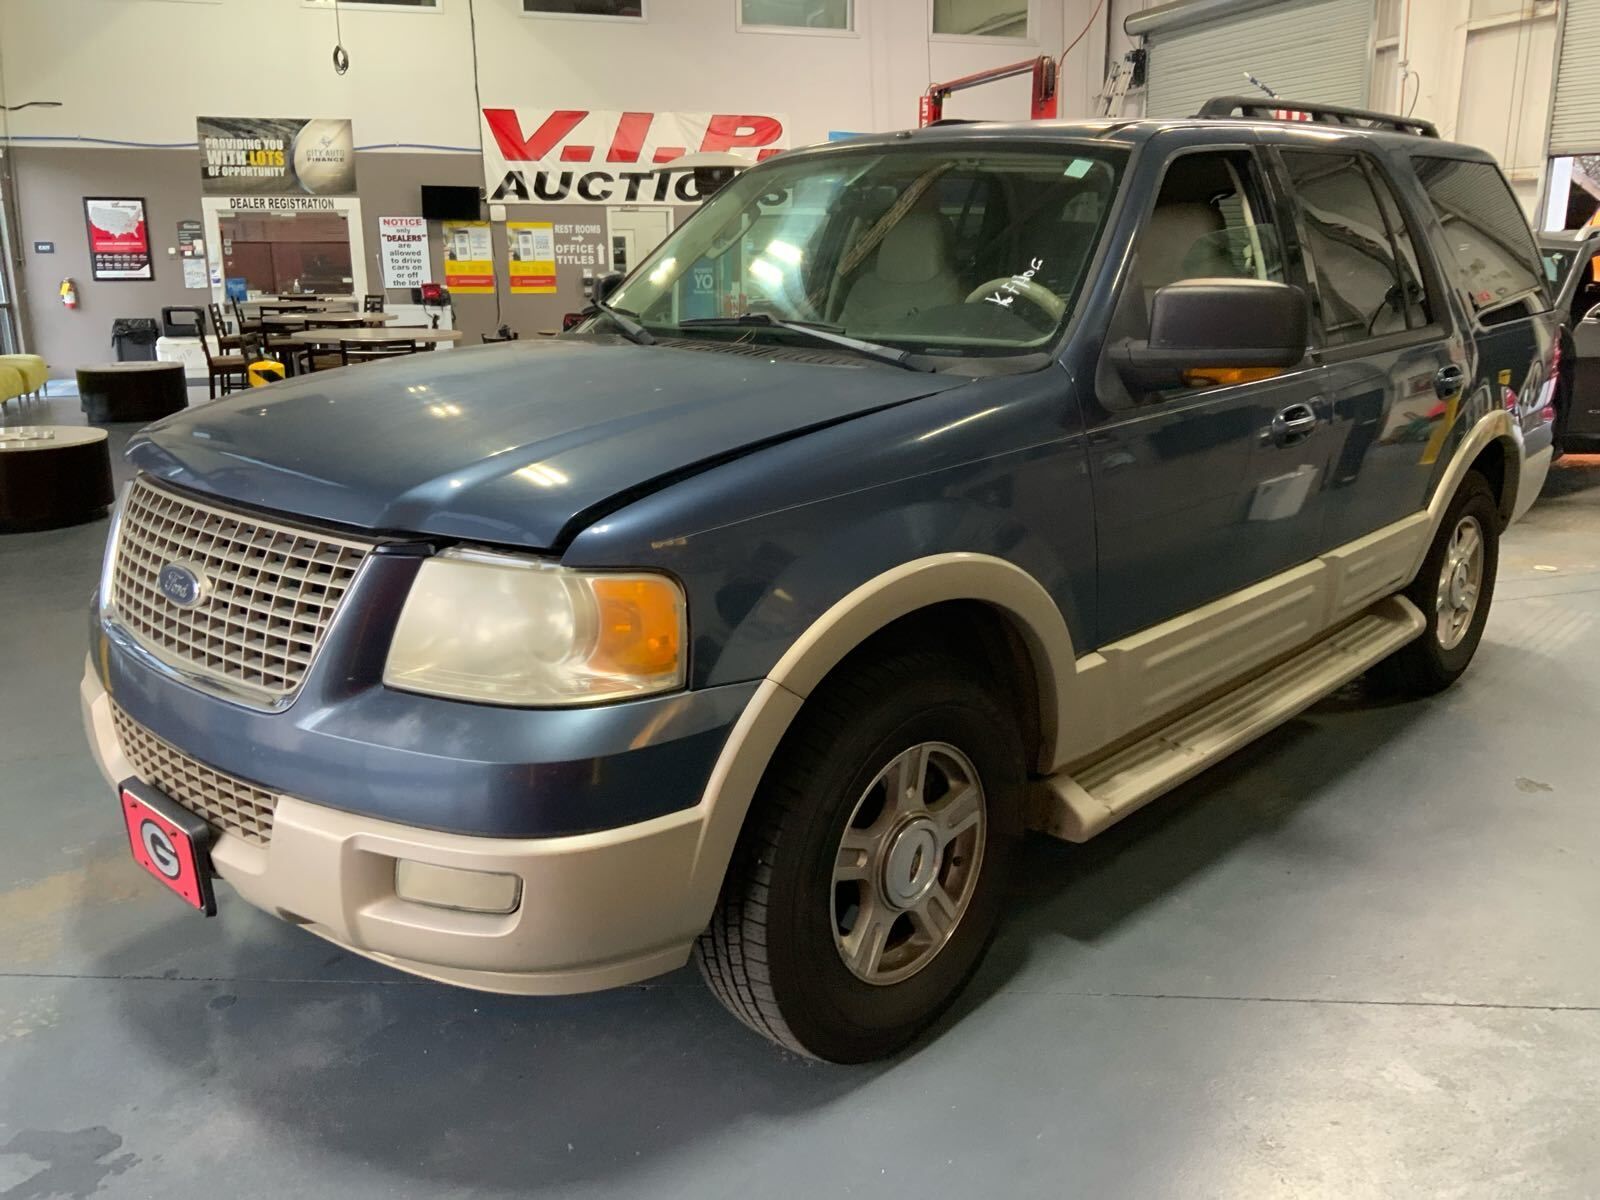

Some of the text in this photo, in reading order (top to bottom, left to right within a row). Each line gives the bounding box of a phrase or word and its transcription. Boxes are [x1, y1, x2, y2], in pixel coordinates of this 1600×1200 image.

[205, 138, 284, 150] PROVIDING YOU
[206, 150, 285, 166] WITH LOTS
[208, 166, 285, 177] OF OPPORTUNITY
[230, 198, 334, 209] DEALER REGISTRATION
[555, 224, 601, 234] REST ROOMS
[382, 234, 426, 242] "DEALERS"
[555, 244, 595, 254] OFFICE
[556, 255, 595, 265] TITLES
[165, 571, 189, 598] Ford
